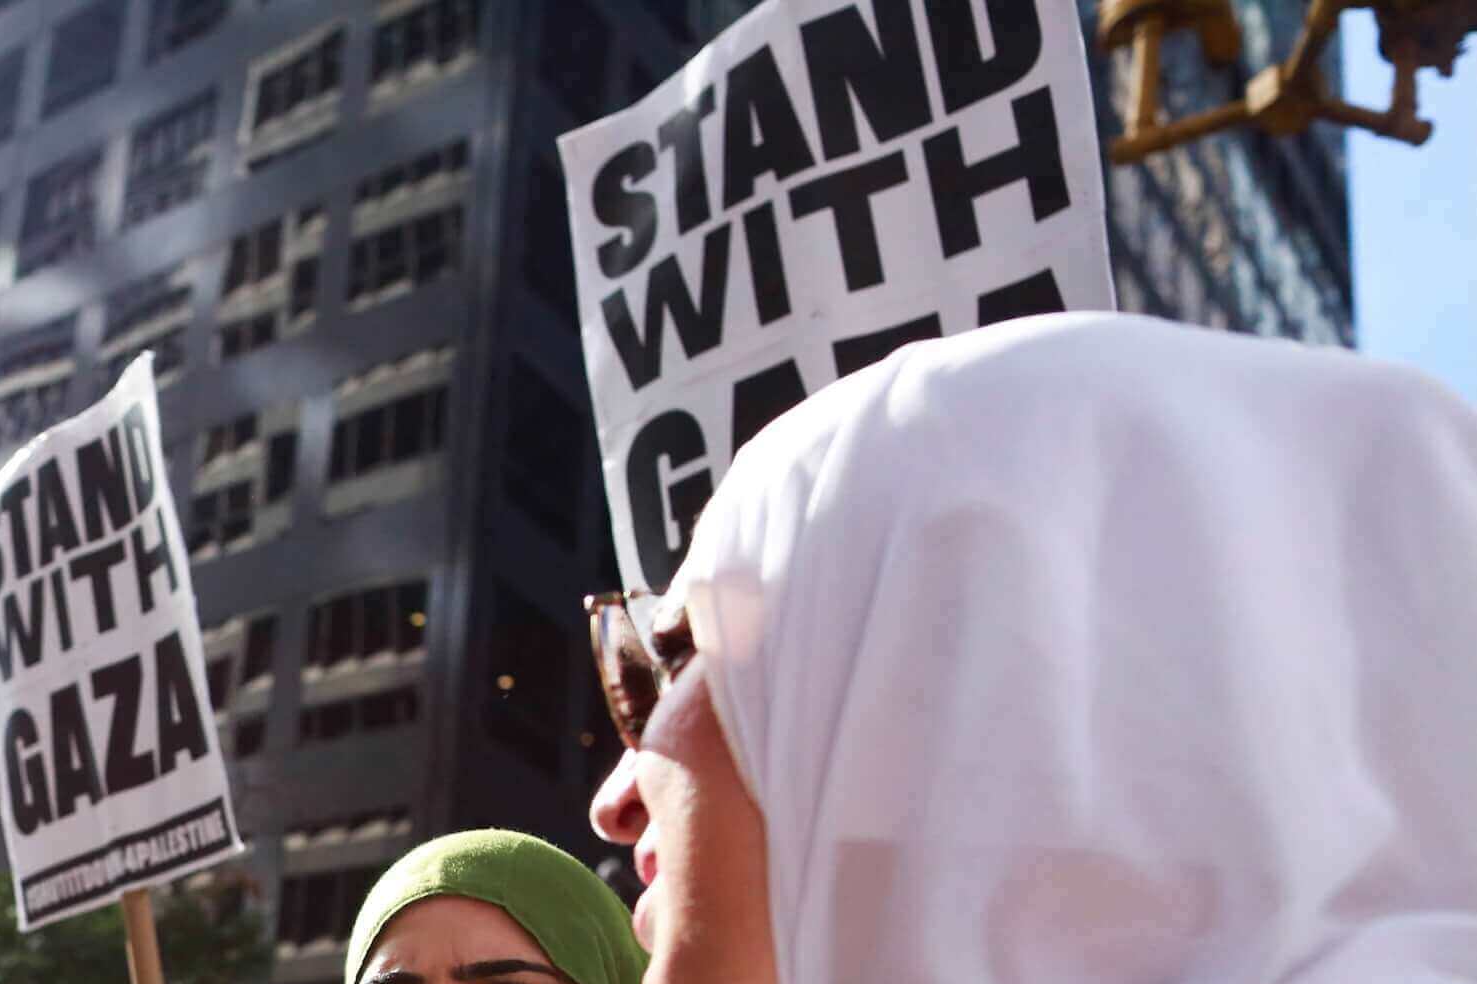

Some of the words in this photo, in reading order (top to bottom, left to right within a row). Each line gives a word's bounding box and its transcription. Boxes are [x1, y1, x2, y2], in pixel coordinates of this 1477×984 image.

[591, 0, 1042, 280] STAND
[600, 85, 1071, 393] WITH
[5, 629, 209, 836] GAZA
